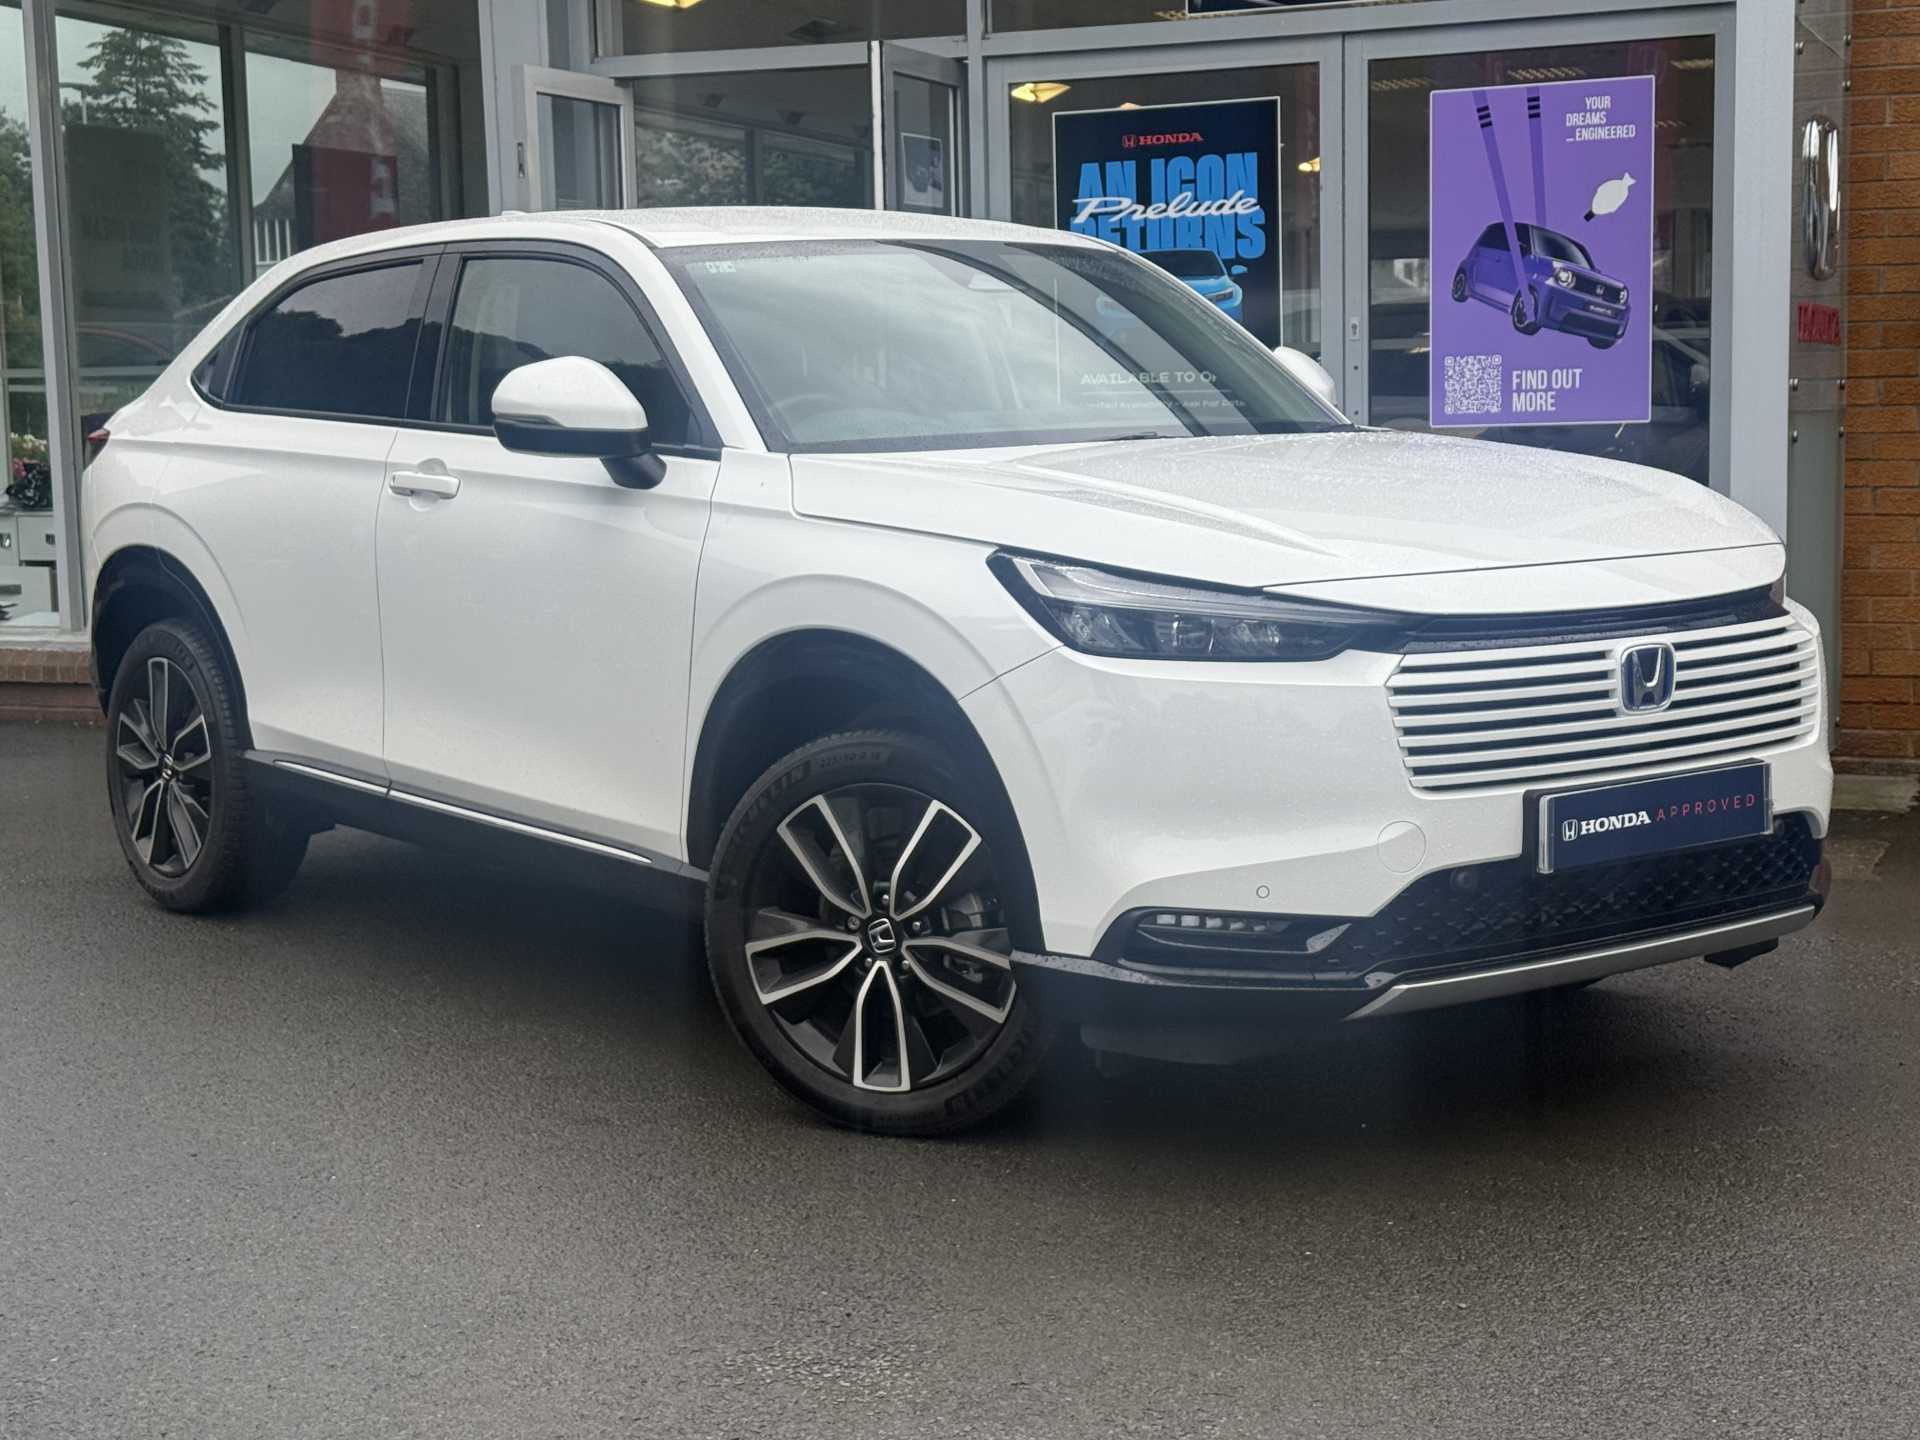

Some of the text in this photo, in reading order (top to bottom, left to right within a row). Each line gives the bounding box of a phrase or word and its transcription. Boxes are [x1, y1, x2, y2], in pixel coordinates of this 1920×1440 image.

[1585, 95, 1611, 109] YOUR
[1566, 111, 1607, 127] DREAMS
[1139, 132, 1204, 145] HONDA
[1076, 152, 1258, 214] AN ICON
[1072, 190, 1261, 224] Prelude
[1080, 371, 1170, 385] AVAILABLE
[1175, 371, 1196, 383] TO
[1512, 368, 1583, 390] FIND OUT
[1512, 391, 1556, 412] MORE
[1580, 811, 1651, 835] HONDA
[1656, 794, 1755, 821] APPROVED
